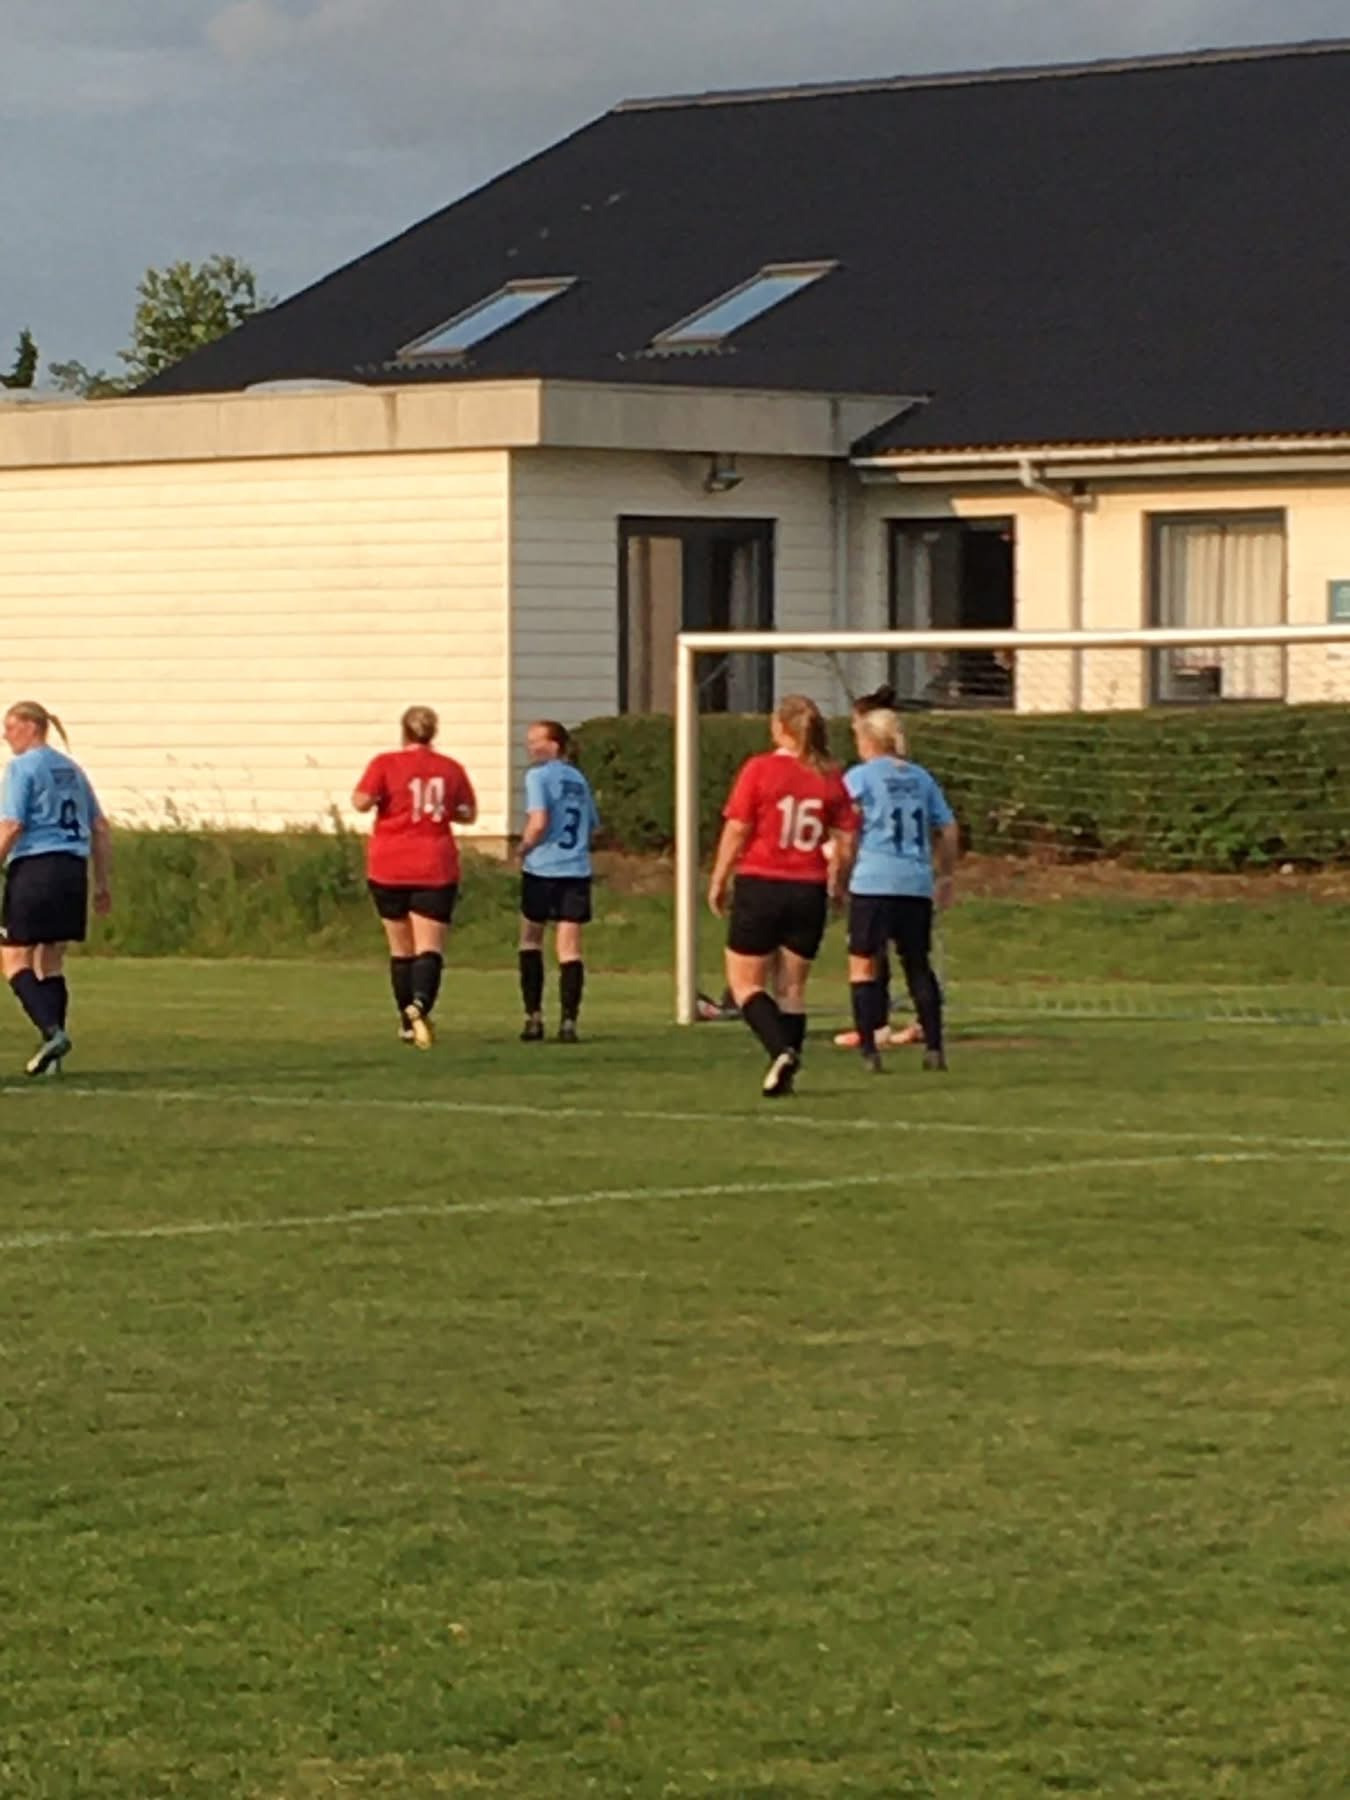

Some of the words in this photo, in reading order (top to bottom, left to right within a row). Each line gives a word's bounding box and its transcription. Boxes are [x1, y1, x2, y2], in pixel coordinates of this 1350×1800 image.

[558, 808, 581, 850] 3
[777, 795, 823, 851] 16
[891, 807, 925, 856] 11
